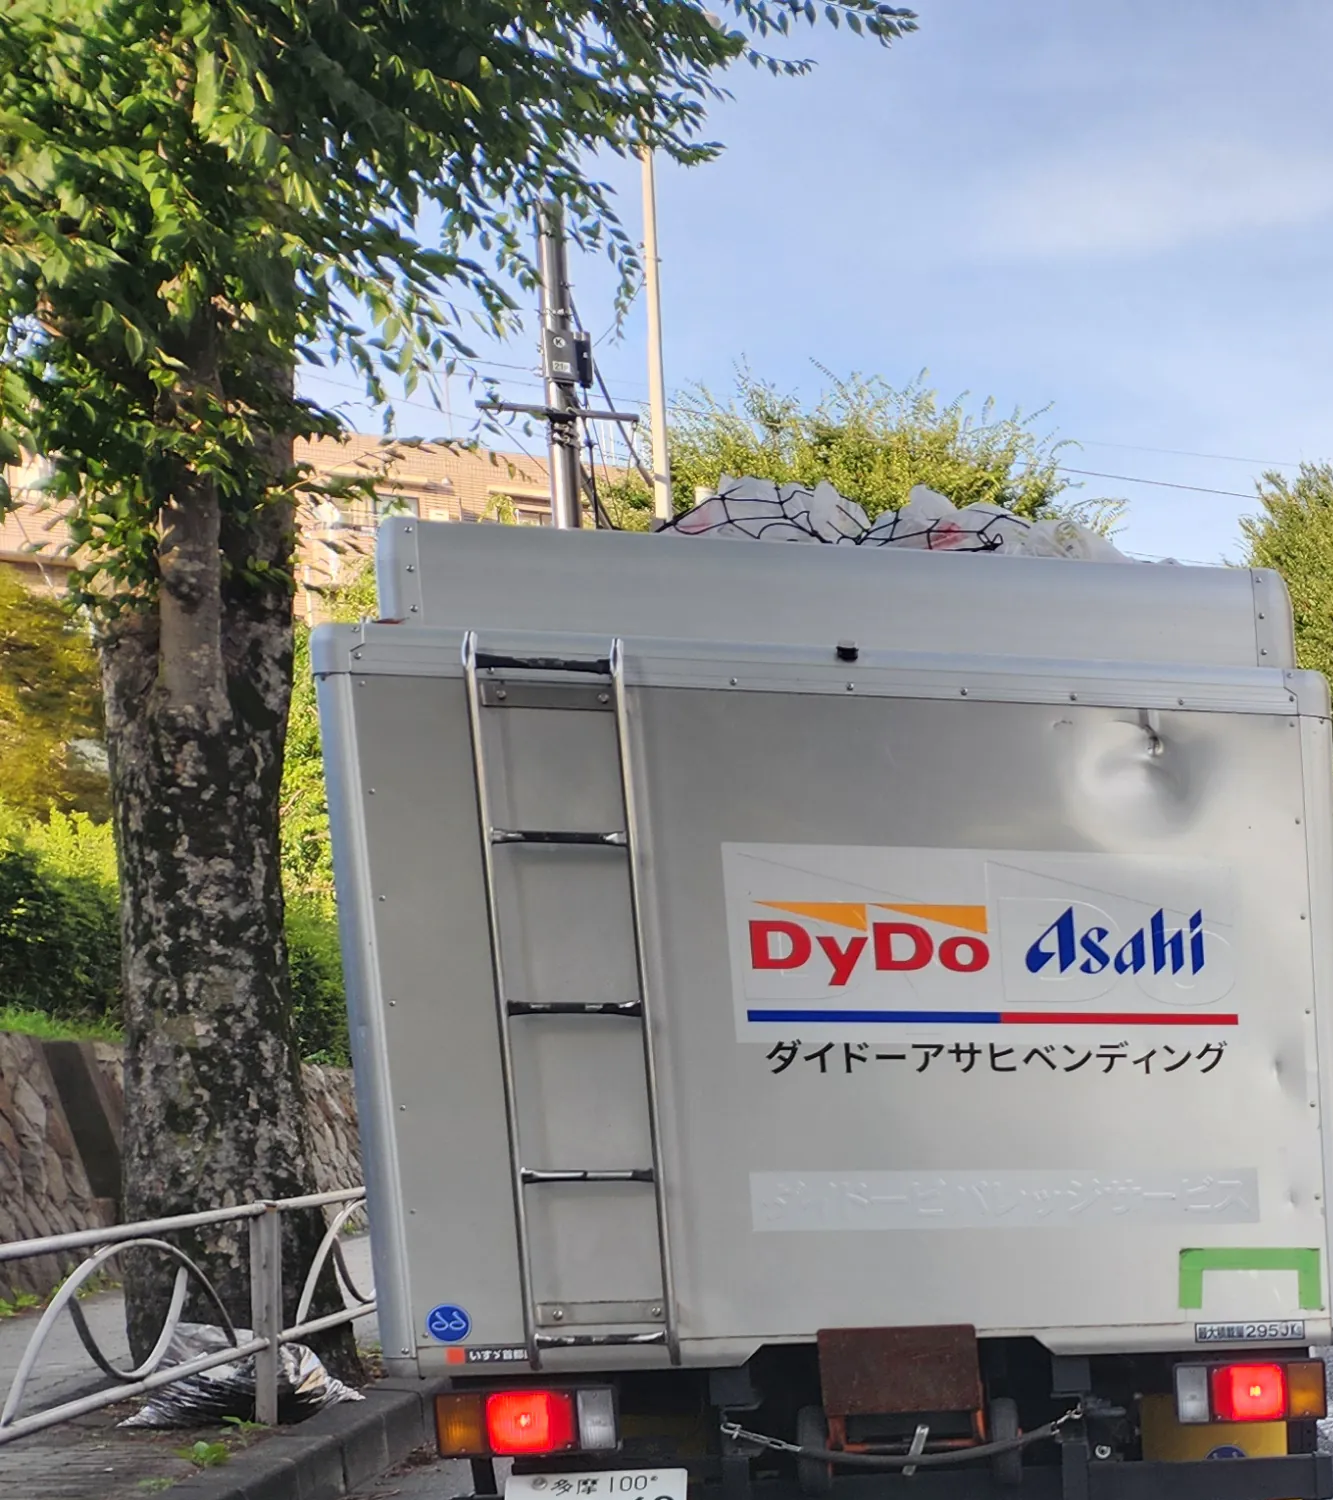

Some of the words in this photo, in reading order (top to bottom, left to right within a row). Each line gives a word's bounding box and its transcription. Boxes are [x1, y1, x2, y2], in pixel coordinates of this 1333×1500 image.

[748, 920, 990, 986] DyDo
[1025, 906, 1205, 975] Asahi
[766, 1040, 1228, 1075] ダイドーアサヒベンディング
[550, 1478, 599, 1496] 多摩
[609, 1475, 648, 1493] 100
